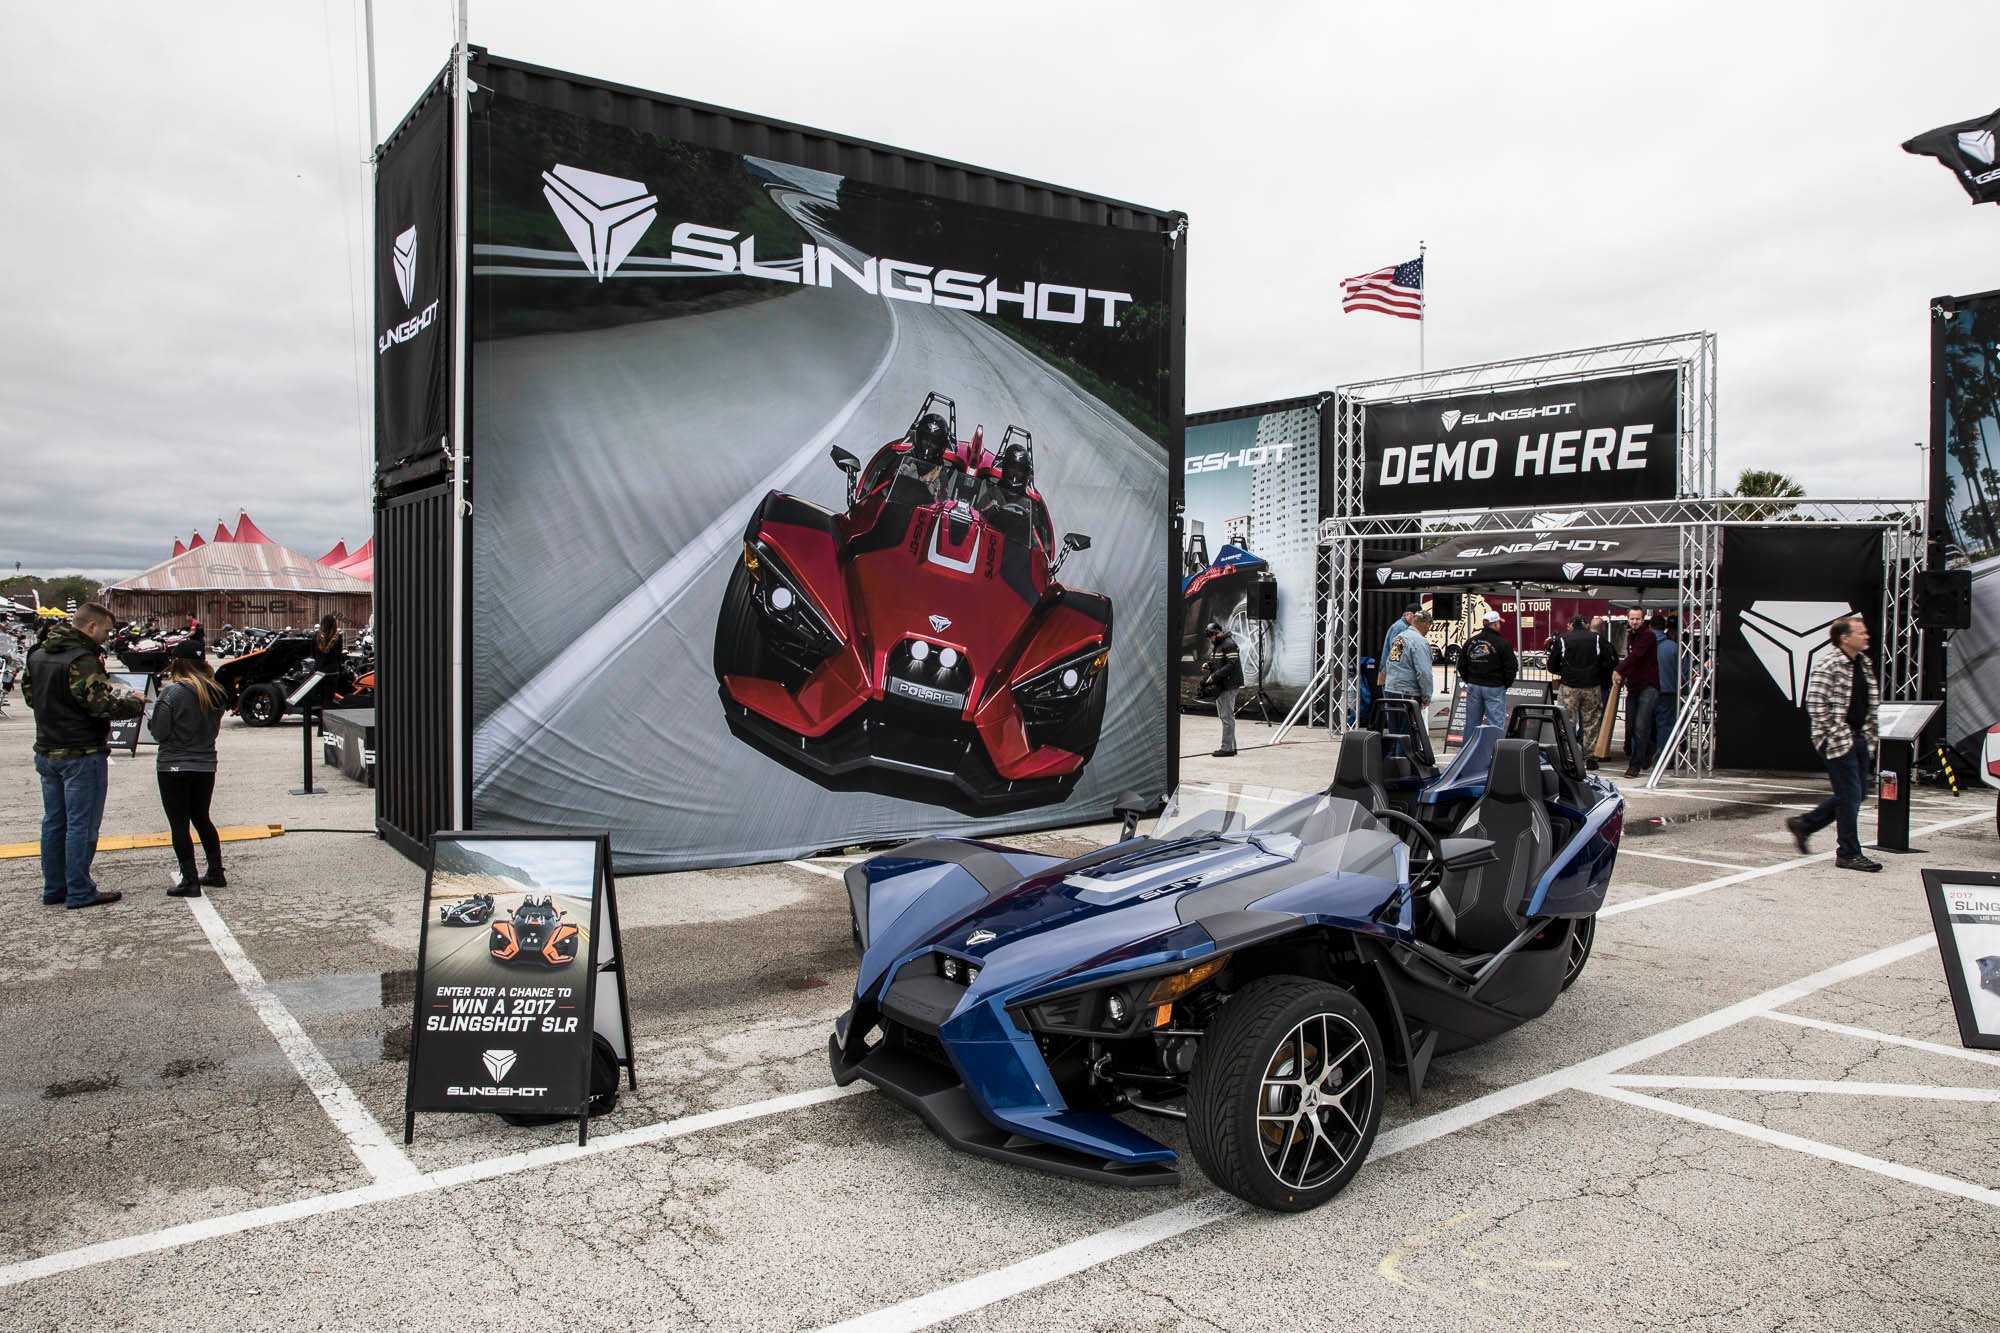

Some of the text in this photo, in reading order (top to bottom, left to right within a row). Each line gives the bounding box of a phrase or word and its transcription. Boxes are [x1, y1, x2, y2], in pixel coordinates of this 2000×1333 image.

[671, 222, 1133, 327] SLINGSHOT
[1461, 403, 1577, 425] SLINGSHOT
[1379, 424, 1654, 486] DEMO HERE
[1457, 540, 1620, 558] SLINGSHOT
[1391, 568, 1477, 580] SLINGSHOT
[1528, 601, 1551, 611] TOUR
[898, 683, 954, 705] POLARIS
[436, 986, 572, 998] ENTER FOR A CHANCE TO
[451, 998, 556, 1015] WIN A 2017
[541, 1016, 578, 1033] SLR
[446, 1086, 548, 1097] SLINGSHOT
